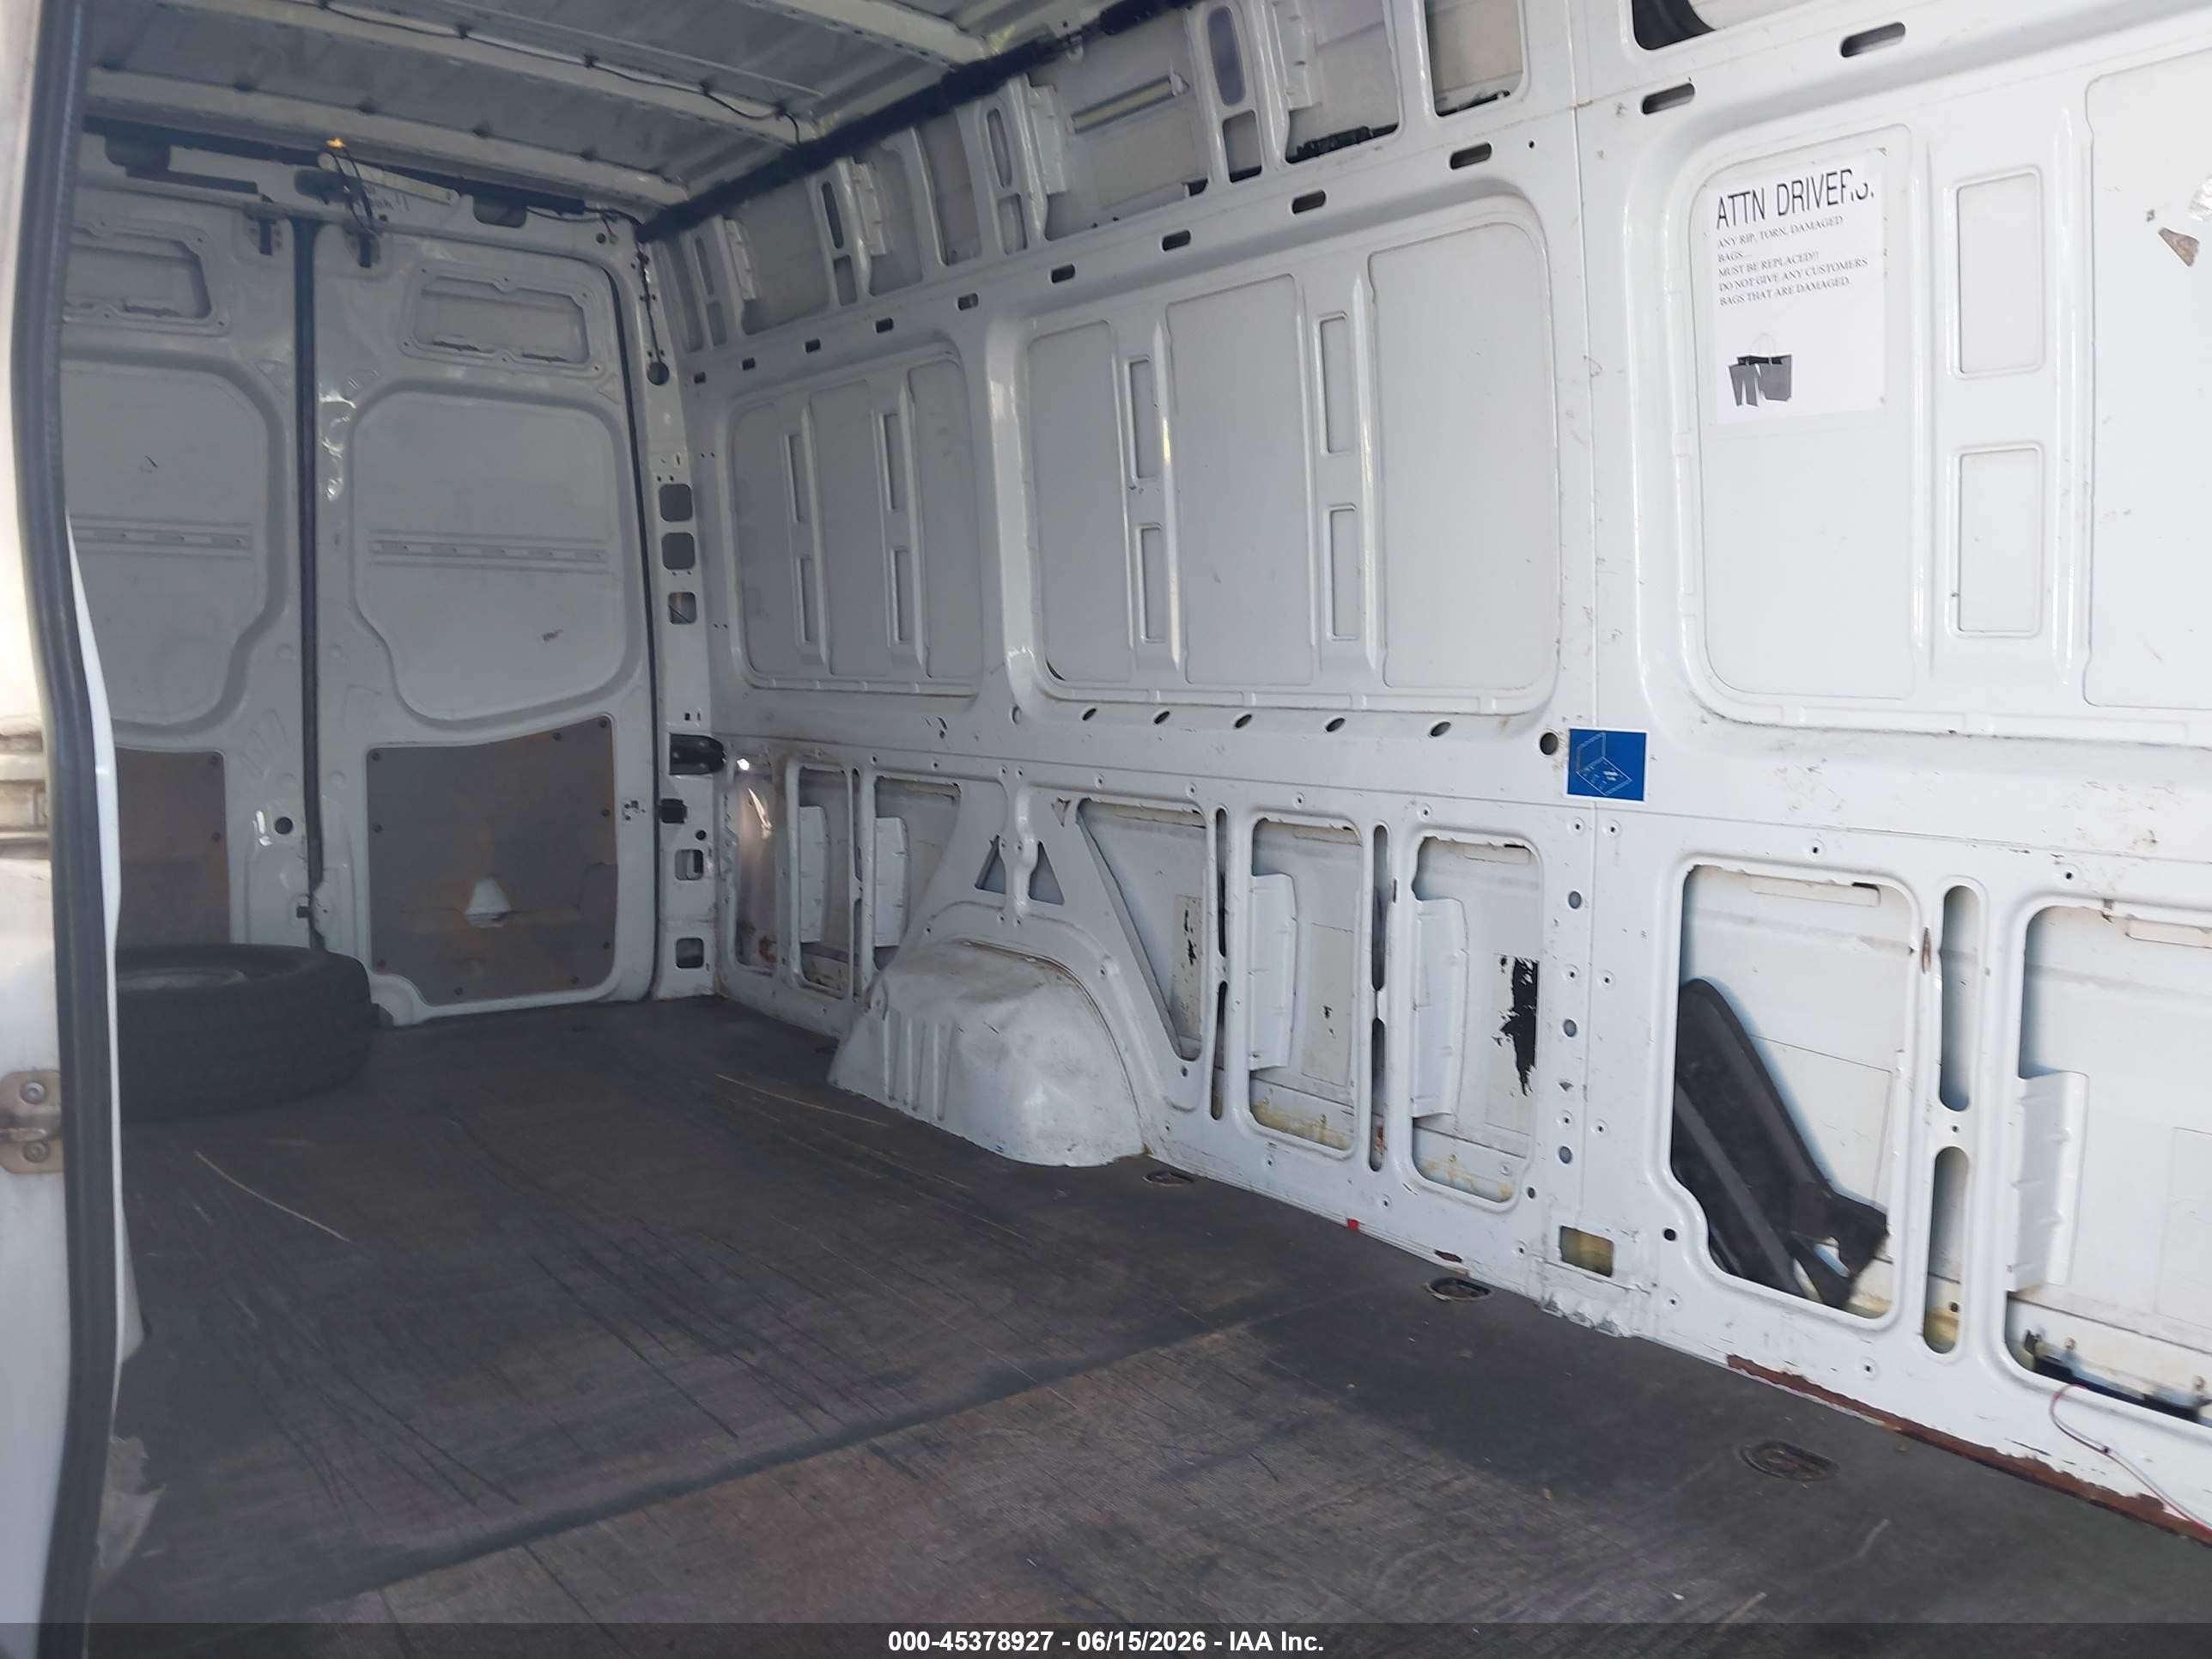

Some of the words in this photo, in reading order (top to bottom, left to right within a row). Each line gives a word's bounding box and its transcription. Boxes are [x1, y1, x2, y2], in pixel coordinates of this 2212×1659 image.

[1717, 187, 1765, 229] ATTN
[1717, 236, 1737, 249] ANY
[1790, 215, 1844, 234] DAMAGED
[1718, 264, 1745, 278] MUST
[1746, 261, 1759, 273] BE
[1718, 281, 1734, 293] DO
[1734, 276, 1753, 289] NOT
[1754, 273, 1781, 287] GIVE
[1782, 267, 1803, 281] ANY
[1804, 257, 1868, 276] CUSTOMERS
[1719, 294, 1746, 307] BAGS
[1747, 289, 1772, 302] THAT
[1774, 284, 1794, 297] ARE
